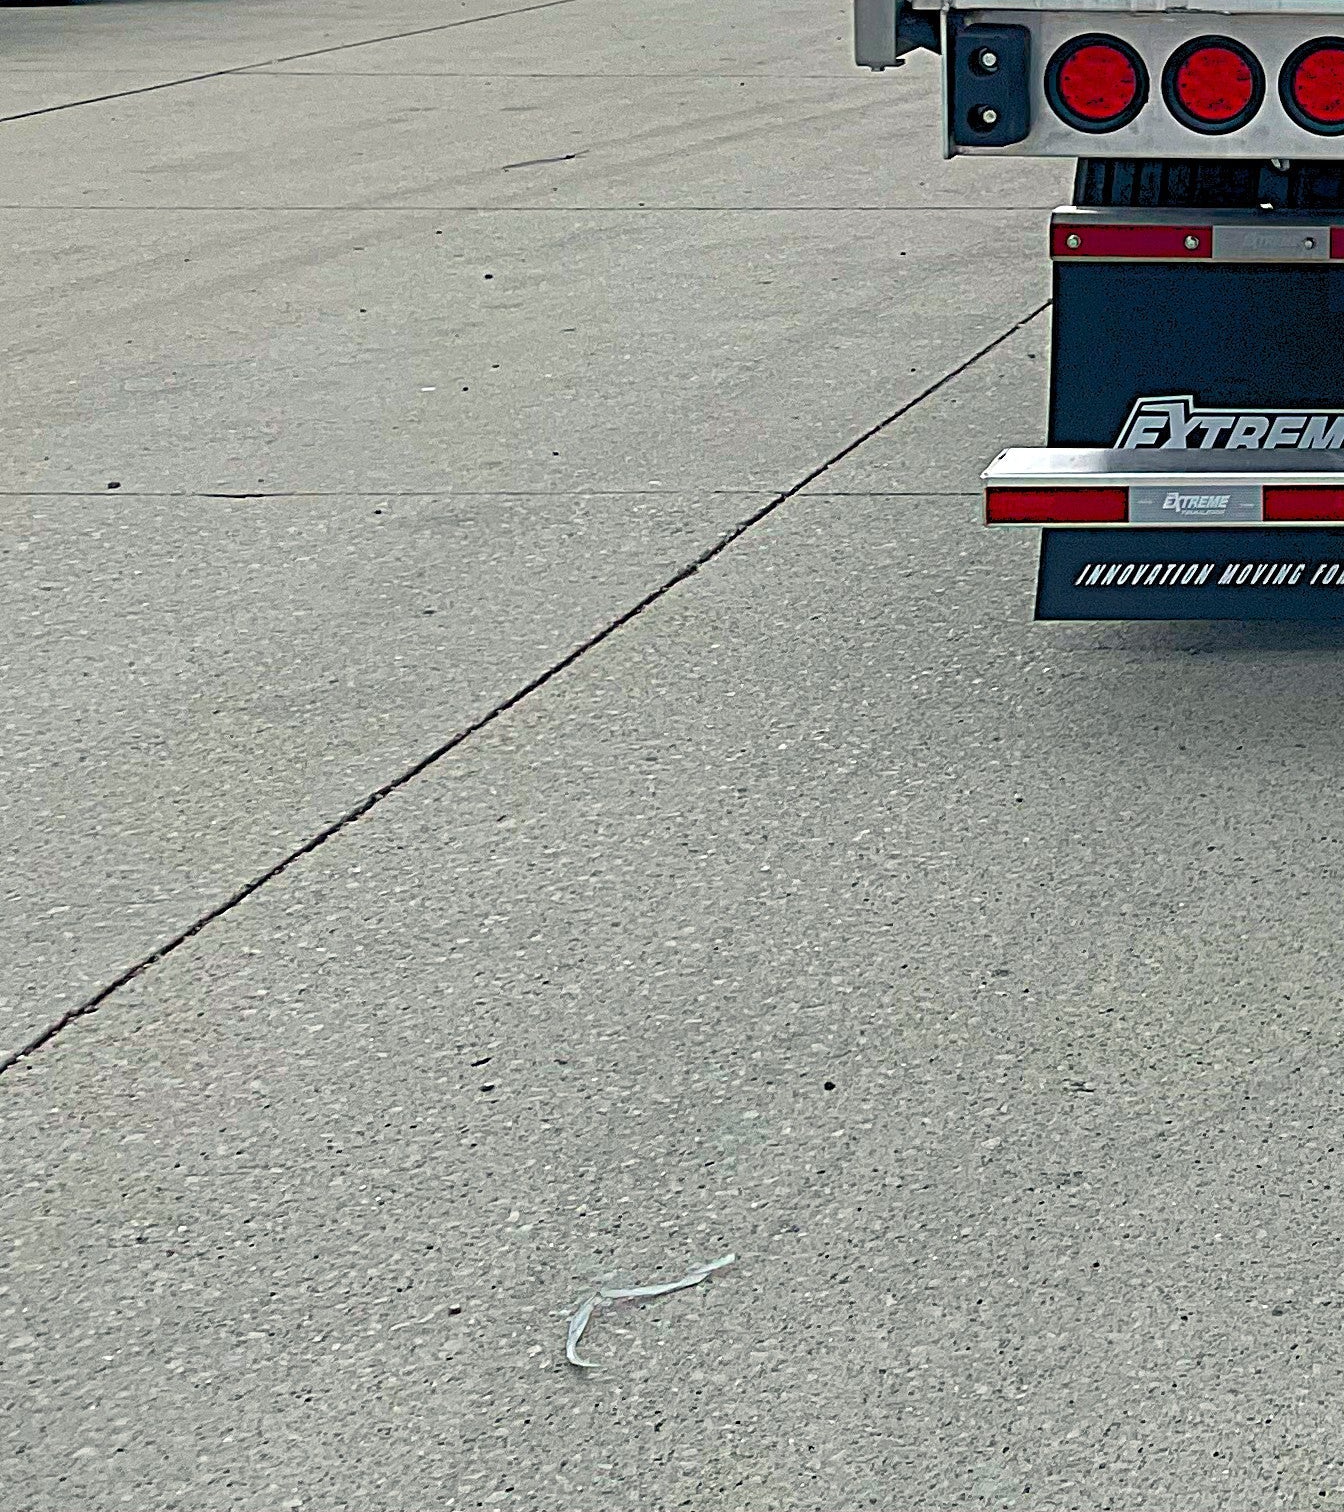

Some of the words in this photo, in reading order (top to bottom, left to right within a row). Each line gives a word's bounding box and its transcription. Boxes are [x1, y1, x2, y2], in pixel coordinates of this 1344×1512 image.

[1162, 491, 1231, 513] EXTREME
[1075, 563, 1214, 586] INNOVATION
[1217, 563, 1306, 586] MOVING
